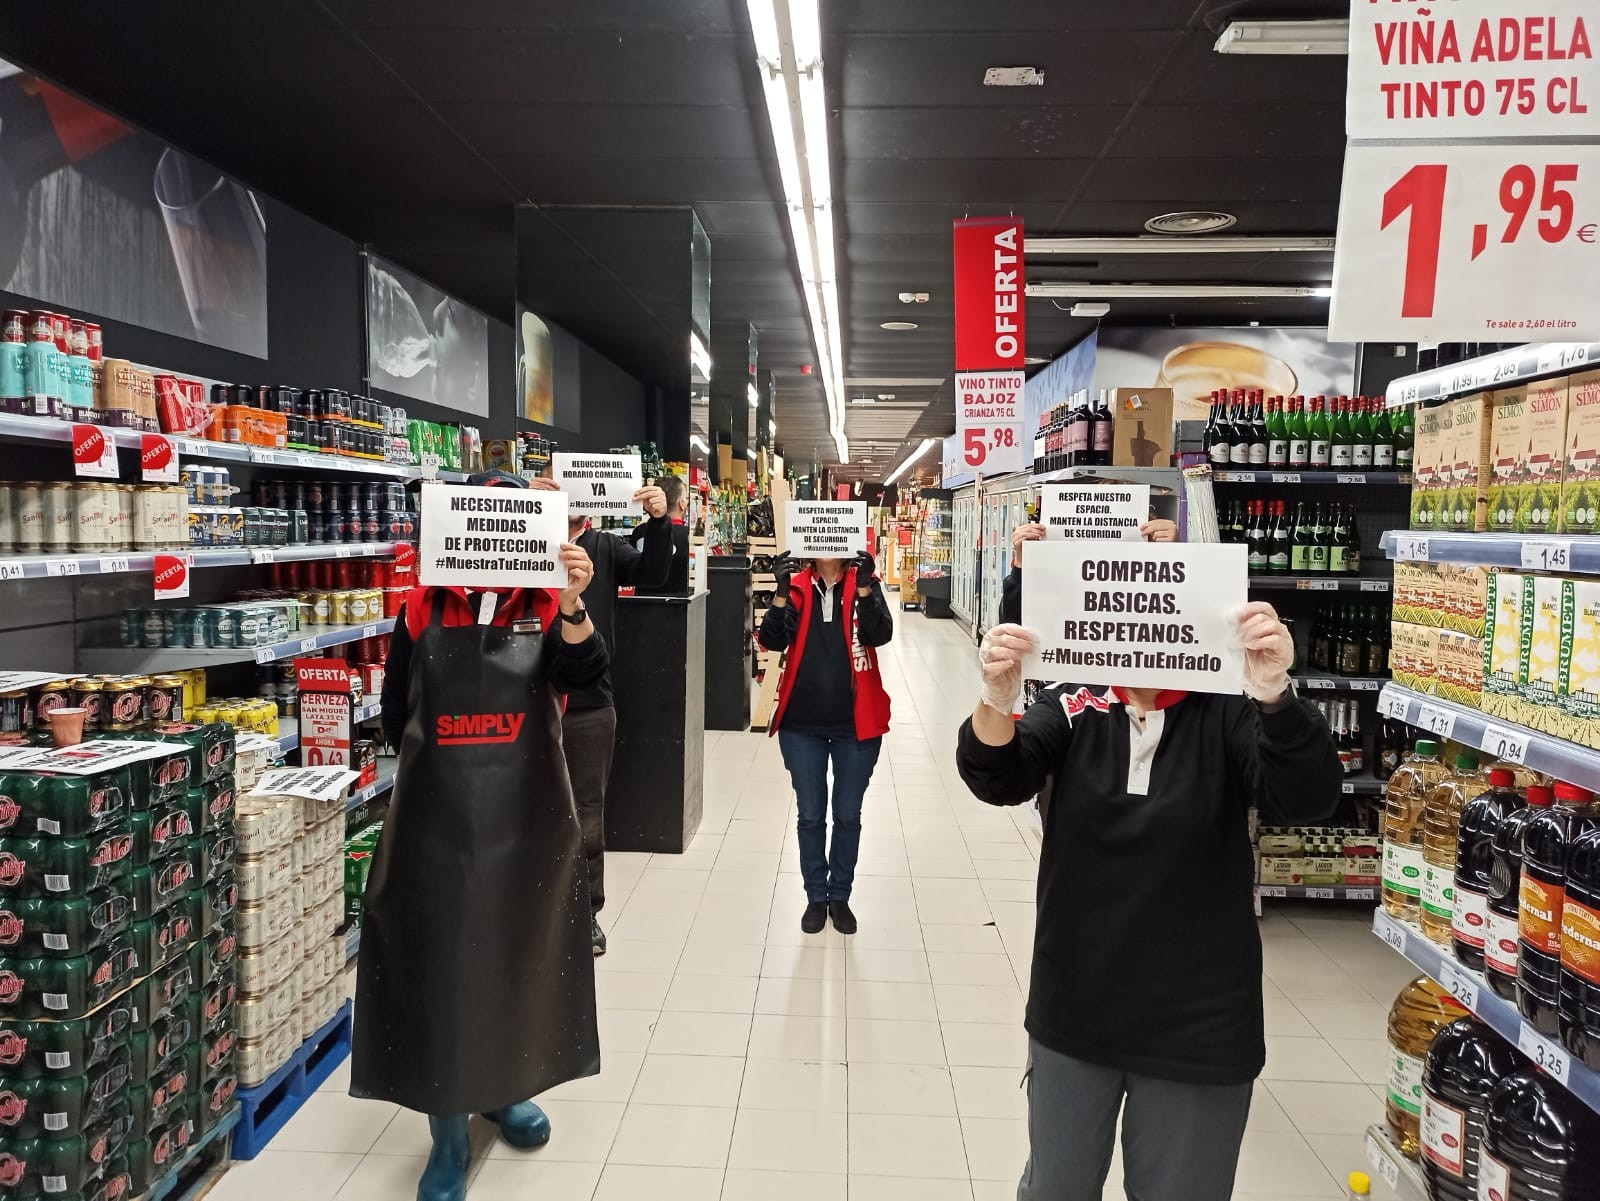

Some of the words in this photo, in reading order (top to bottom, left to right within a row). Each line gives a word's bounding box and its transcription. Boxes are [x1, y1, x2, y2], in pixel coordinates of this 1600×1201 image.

[1374, 8, 1462, 66] VIÑA
[1470, 16, 1593, 63] ADELA
[1380, 79, 1486, 119] TINTO
[1495, 78, 1536, 115] 75
[1546, 77, 1588, 114] CL
[994, 226, 1018, 359] OFERTA
[1486, 319, 1497, 328] Te
[1498, 319, 1516, 328] sale
[1526, 319, 1545, 329] 2,60
[1547, 319, 1556, 328] el
[1557, 318, 1577, 328] litro
[959, 377, 986, 390] VINO
[987, 377, 1021, 390] TINTO
[963, 393, 1016, 405] BAJOZ
[1538, 387, 1555, 399] DON
[964, 408, 995, 418] CRIANZA
[996, 408, 1005, 418] 75
[1006, 408, 1015, 417] CL
[75, 432, 103, 457] OFERTA
[142, 443, 169, 463] OFERTA
[611, 460, 624, 469] DEL
[562, 470, 593, 479] HORARIO
[594, 470, 633, 479] COMERCIAL
[591, 482, 607, 496] YA
[1058, 492, 1092, 502] RESPETA
[1093, 493, 1132, 503] NUESTRO
[450, 497, 543, 514] NECESITAMOS
[798, 507, 824, 515] RESPETA
[825, 507, 854, 515] NUESTRO
[1075, 504, 1112, 515] ESPACIO.
[466, 517, 527, 533] MEDIDAS
[1049, 516, 1082, 527] MANTEN
[1083, 517, 1093, 527] LA
[1094, 517, 1138, 528] DISTANCIA
[792, 526, 817, 534] MANTEN
[818, 526, 826, 534] LA
[826, 526, 859, 534] DISTANCIA
[1064, 528, 1074, 538] DE
[1075, 528, 1122, 539] SEGURIDAD
[444, 537, 462, 551] DE
[464, 537, 547, 554] PROTECCION
[804, 535, 812, 543] DE
[812, 535, 848, 543] SEGURIDAD
[396, 549, 415, 562] OFERTA
[435, 556, 555, 572] #MuestraTuEnfado
[155, 562, 184, 584] OFERTA
[1081, 559, 1186, 583] COMPRAS
[1084, 591, 1181, 615] BASICAS.
[1064, 620, 1199, 645] RESPETANOS.
[1041, 648, 1222, 673] #MuestraTuEnfado
[299, 668, 349, 682] OFERTA
[301, 694, 348, 706] CERVEZA
[302, 706, 317, 714] SAN
[318, 706, 349, 715] MIGUEL
[315, 738, 336, 747] AHORA
